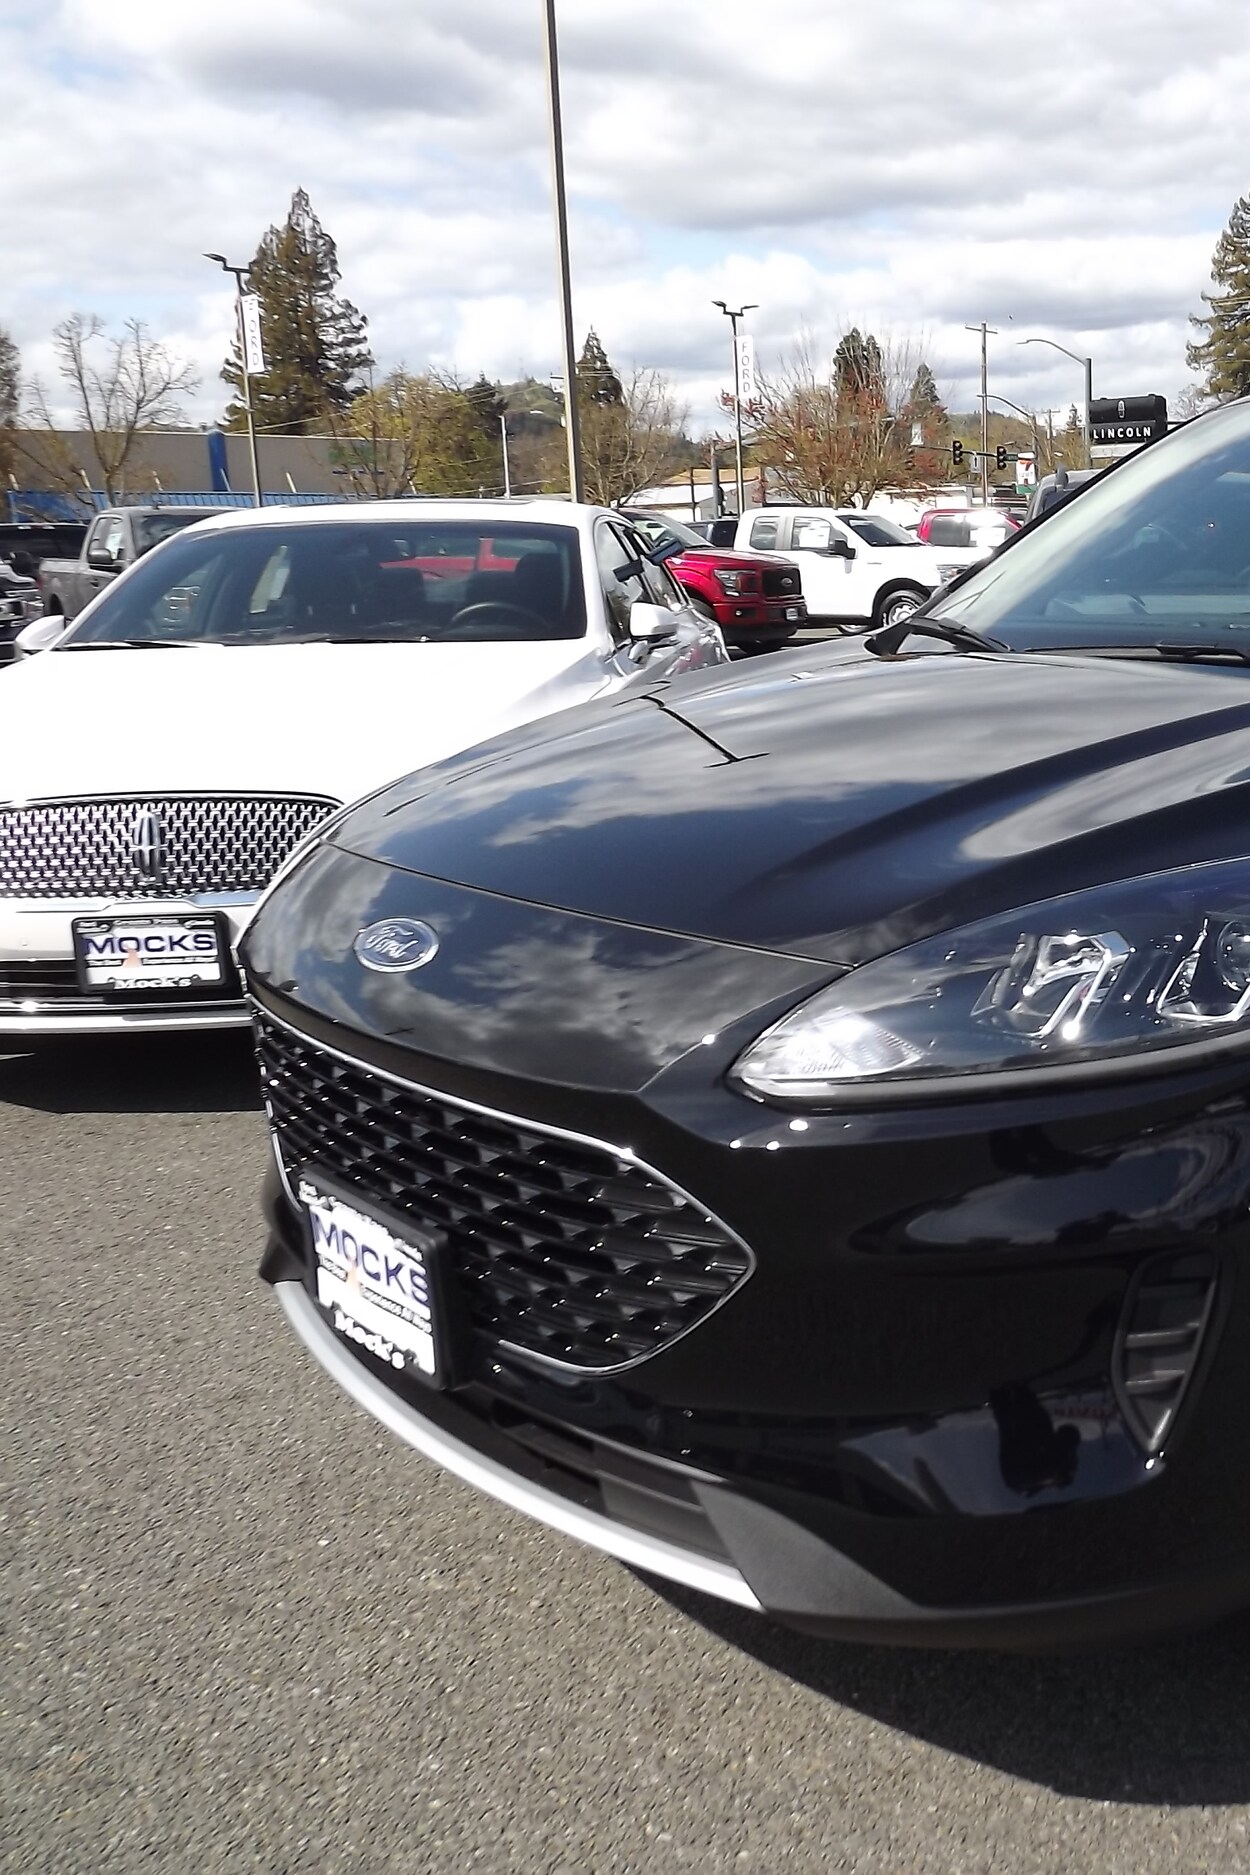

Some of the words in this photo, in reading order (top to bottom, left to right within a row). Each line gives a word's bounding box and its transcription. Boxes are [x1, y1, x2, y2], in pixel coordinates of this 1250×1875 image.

[741, 341, 751, 393] FORD
[1093, 426, 1151, 439] LINCOLN
[83, 933, 214, 955] MOCKS
[113, 977, 193, 990] Mock's
[311, 1212, 430, 1308] MOCKS
